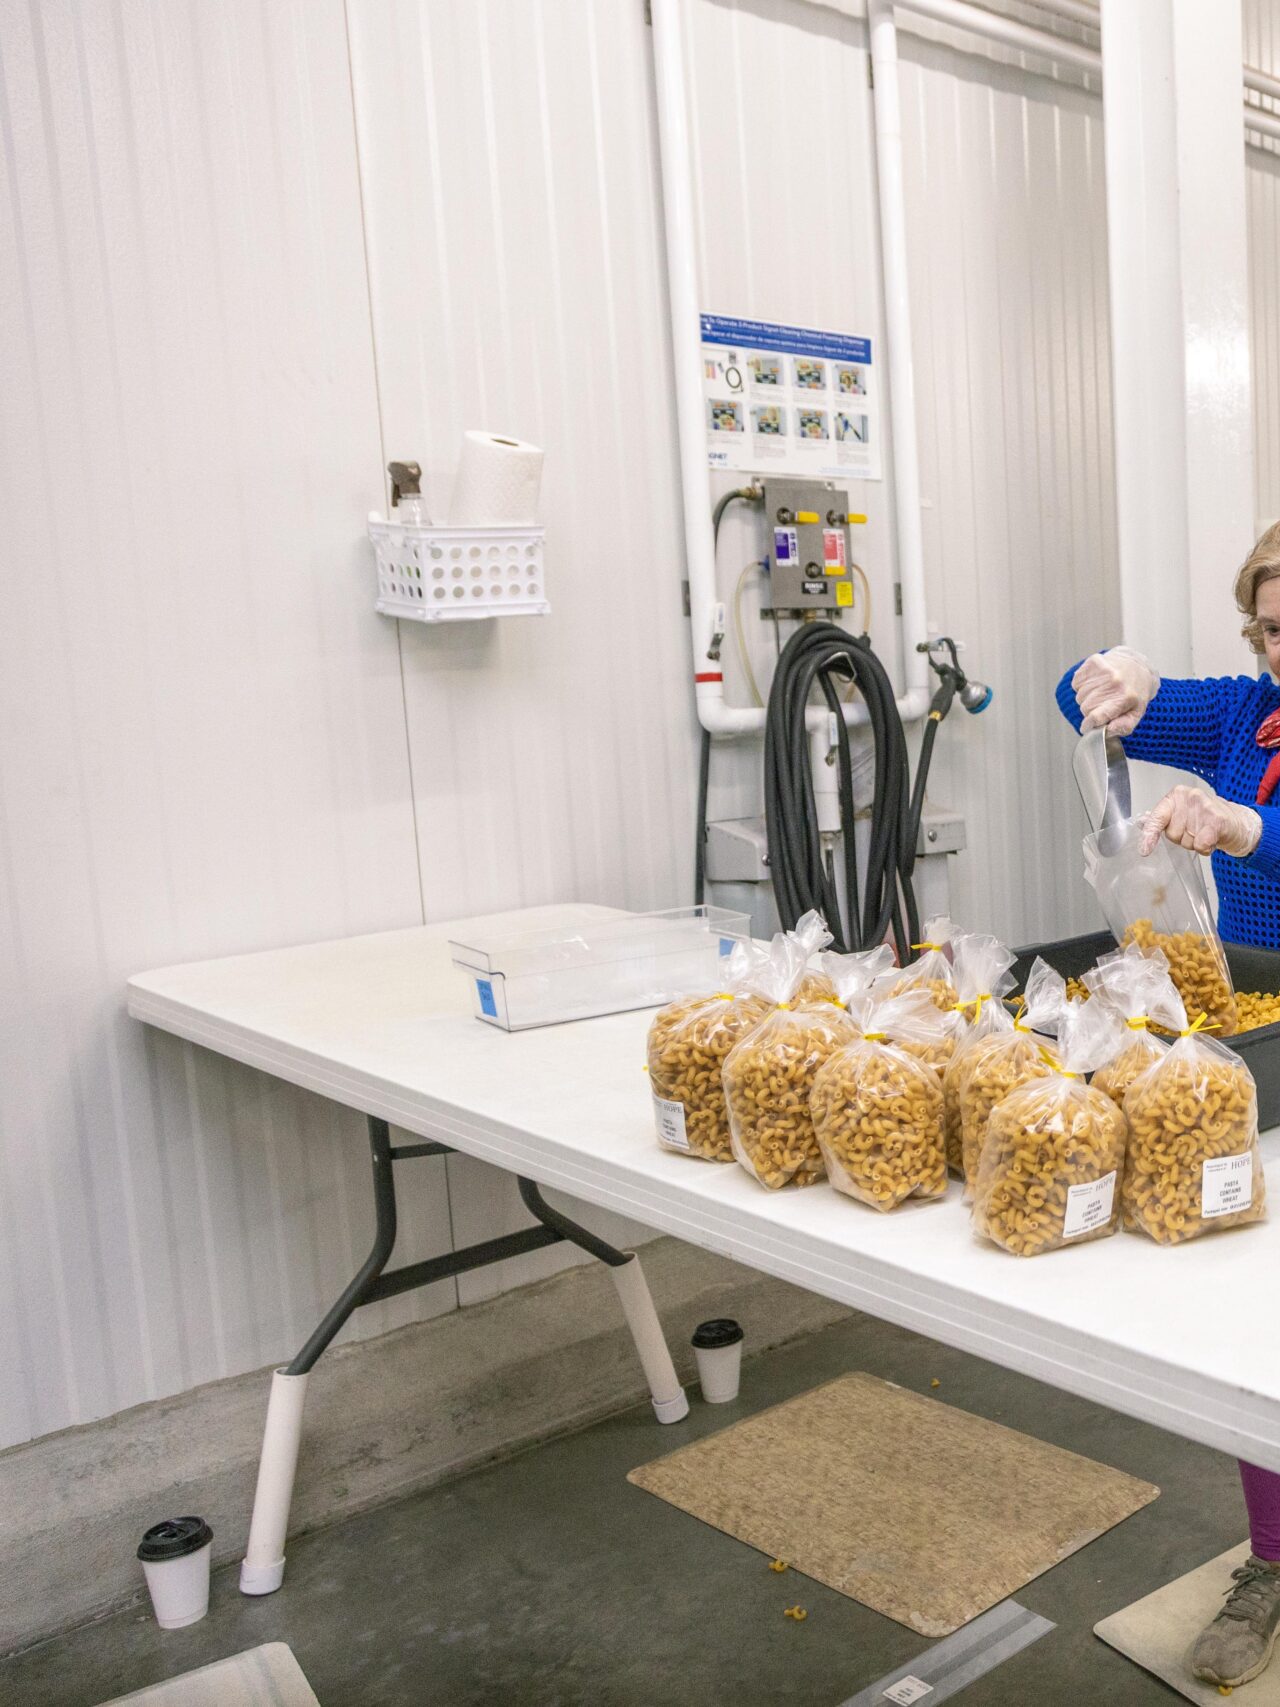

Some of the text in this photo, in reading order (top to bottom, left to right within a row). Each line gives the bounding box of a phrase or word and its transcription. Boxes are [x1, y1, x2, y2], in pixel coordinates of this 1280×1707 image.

[1224, 1179, 1239, 1188] PASTA
[1219, 1186, 1242, 1197] CONTAINS
[1222, 1194, 1239, 1204] WHEAT
